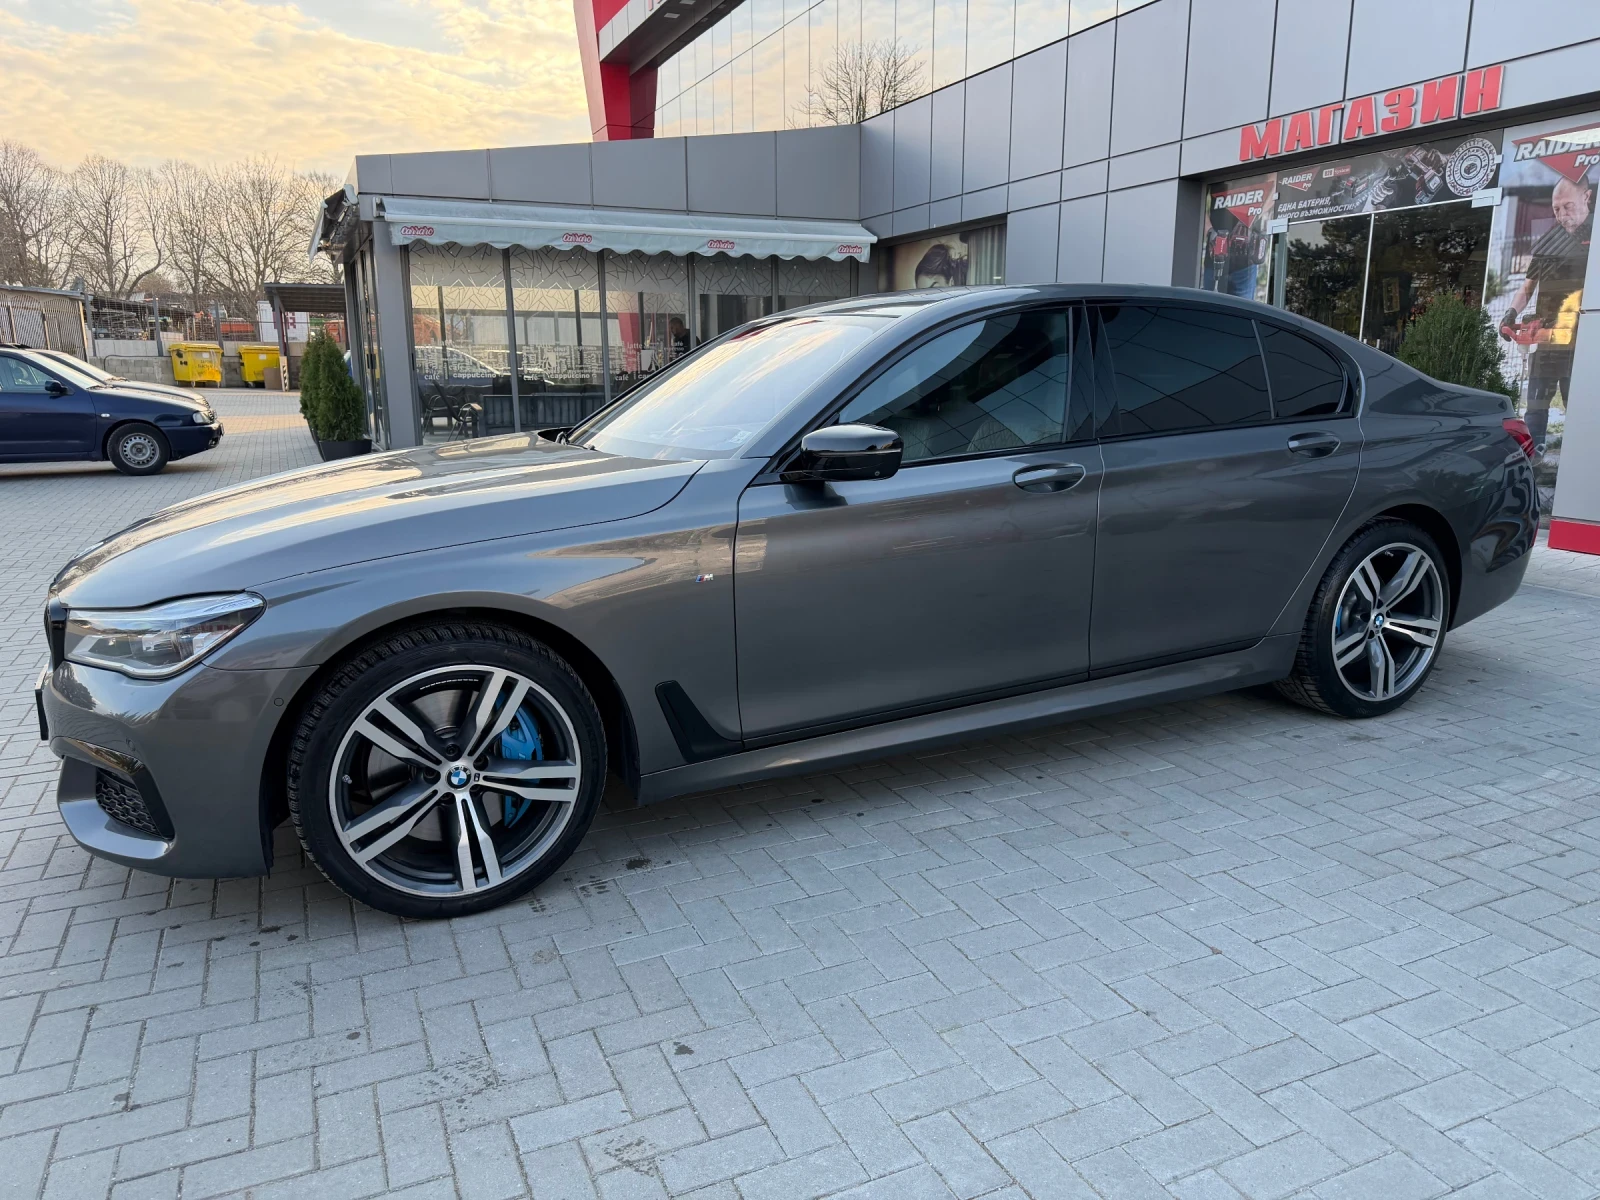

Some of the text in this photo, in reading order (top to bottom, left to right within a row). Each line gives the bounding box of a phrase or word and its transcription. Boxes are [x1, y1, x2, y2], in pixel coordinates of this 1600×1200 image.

[1239, 65, 1504, 162] МАГАЗИН
[1573, 154, 1600, 168] Pro
[1282, 172, 1313, 185] RAIDER
[1214, 189, 1264, 210] RAIDER
[1247, 206, 1262, 216] Pro
[1277, 201, 1297, 213] ЕДНА
[452, 371, 497, 380] cappuccino
